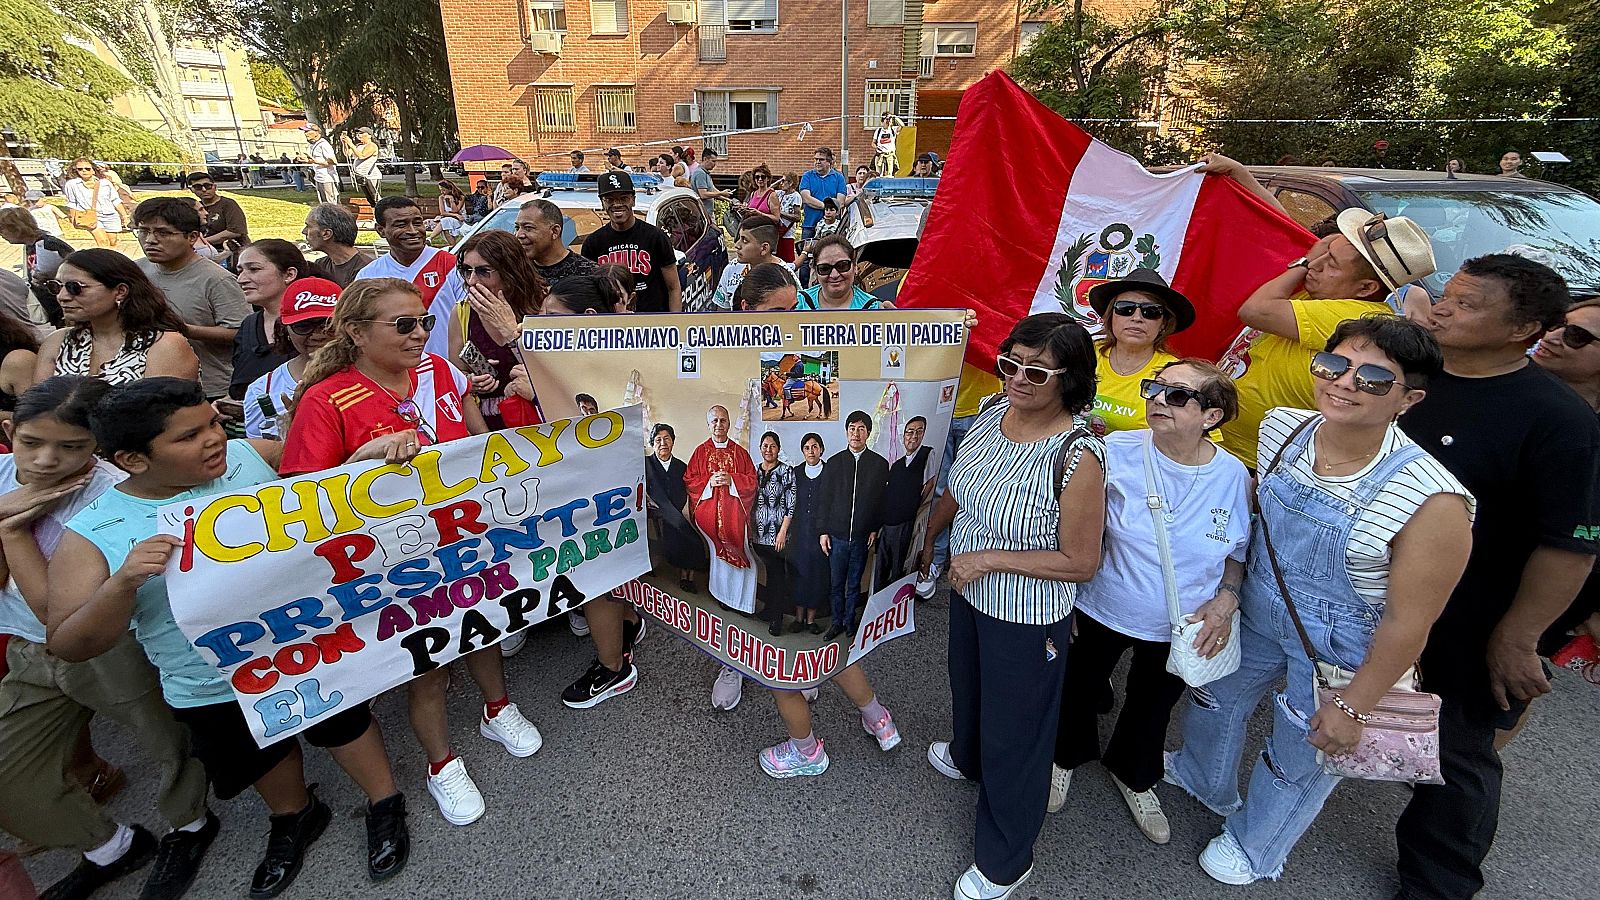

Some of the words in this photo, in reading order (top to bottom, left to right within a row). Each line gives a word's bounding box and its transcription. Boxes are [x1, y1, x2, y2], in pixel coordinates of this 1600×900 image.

[608, 243, 639, 252] CHICAGO
[294, 291, 338, 311] Perú
[523, 328, 574, 350] DESDE
[577, 326, 684, 351] ACHIRAMAYO,
[687, 324, 783, 348] CAJAMARCA
[800, 324, 858, 346] TIERRA
[861, 324, 882, 346] DE
[886, 323, 907, 345] MI
[911, 321, 963, 346] PADRE
[1093, 397, 1113, 412] ON
[1113, 404, 1137, 417] XIV
[314, 477, 541, 584] PERU
[195, 483, 645, 668] PRESENTE!
[231, 622, 365, 695] CON
[376, 562, 518, 642] AMOR
[528, 518, 640, 582] PARA
[253, 678, 344, 738] EL
[400, 574, 587, 677] PAPA
[695, 607, 723, 651] DE
[726, 624, 840, 683] CHICLAYO
